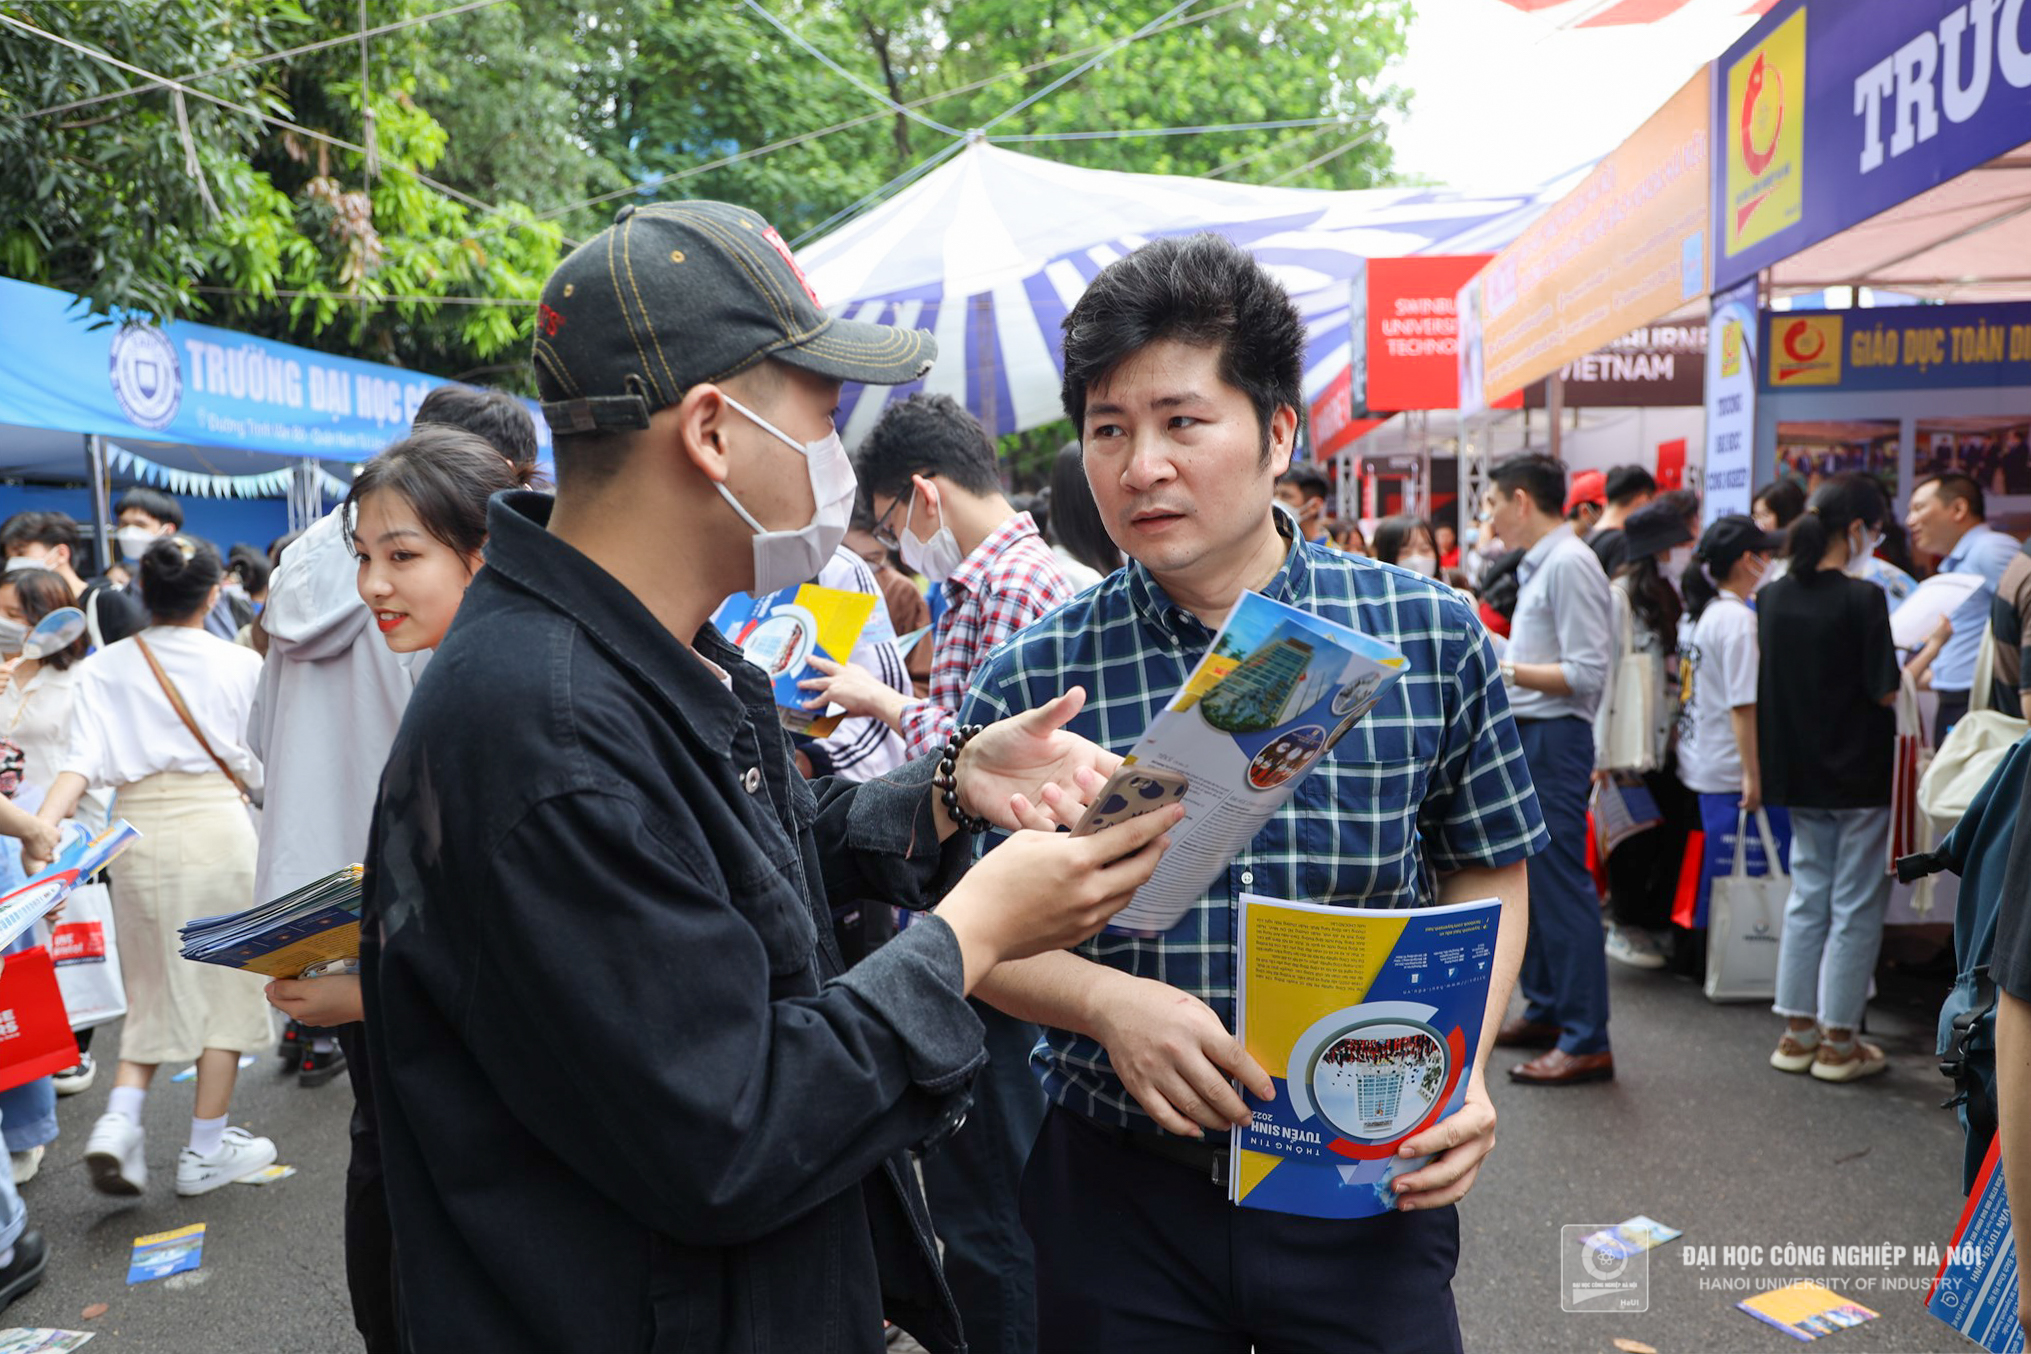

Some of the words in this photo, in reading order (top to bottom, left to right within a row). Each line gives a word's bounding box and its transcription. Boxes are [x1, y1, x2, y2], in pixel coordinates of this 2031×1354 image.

[1851, 322, 1898, 367] GIÁO
[1903, 328, 1945, 373] DỤC
[1951, 318, 2004, 364] TOÀN
[1560, 353, 1675, 381] VIETNAM
[185, 338, 303, 409] TRƯỜNG
[308, 364, 352, 422] ĐẠI
[355, 374, 402, 428] HỌC
[1252, 1111, 1273, 1121] 2022
[1251, 1121, 1281, 1136] SINH
[1281, 1127, 1321, 1144] TUYỂN
[1250, 1137, 1270, 1147] TIN
[1275, 1142, 1320, 1156] THÔNG
[1981, 1229, 2001, 1260] TUYỂN
[1970, 1259, 1986, 1283] SINH
